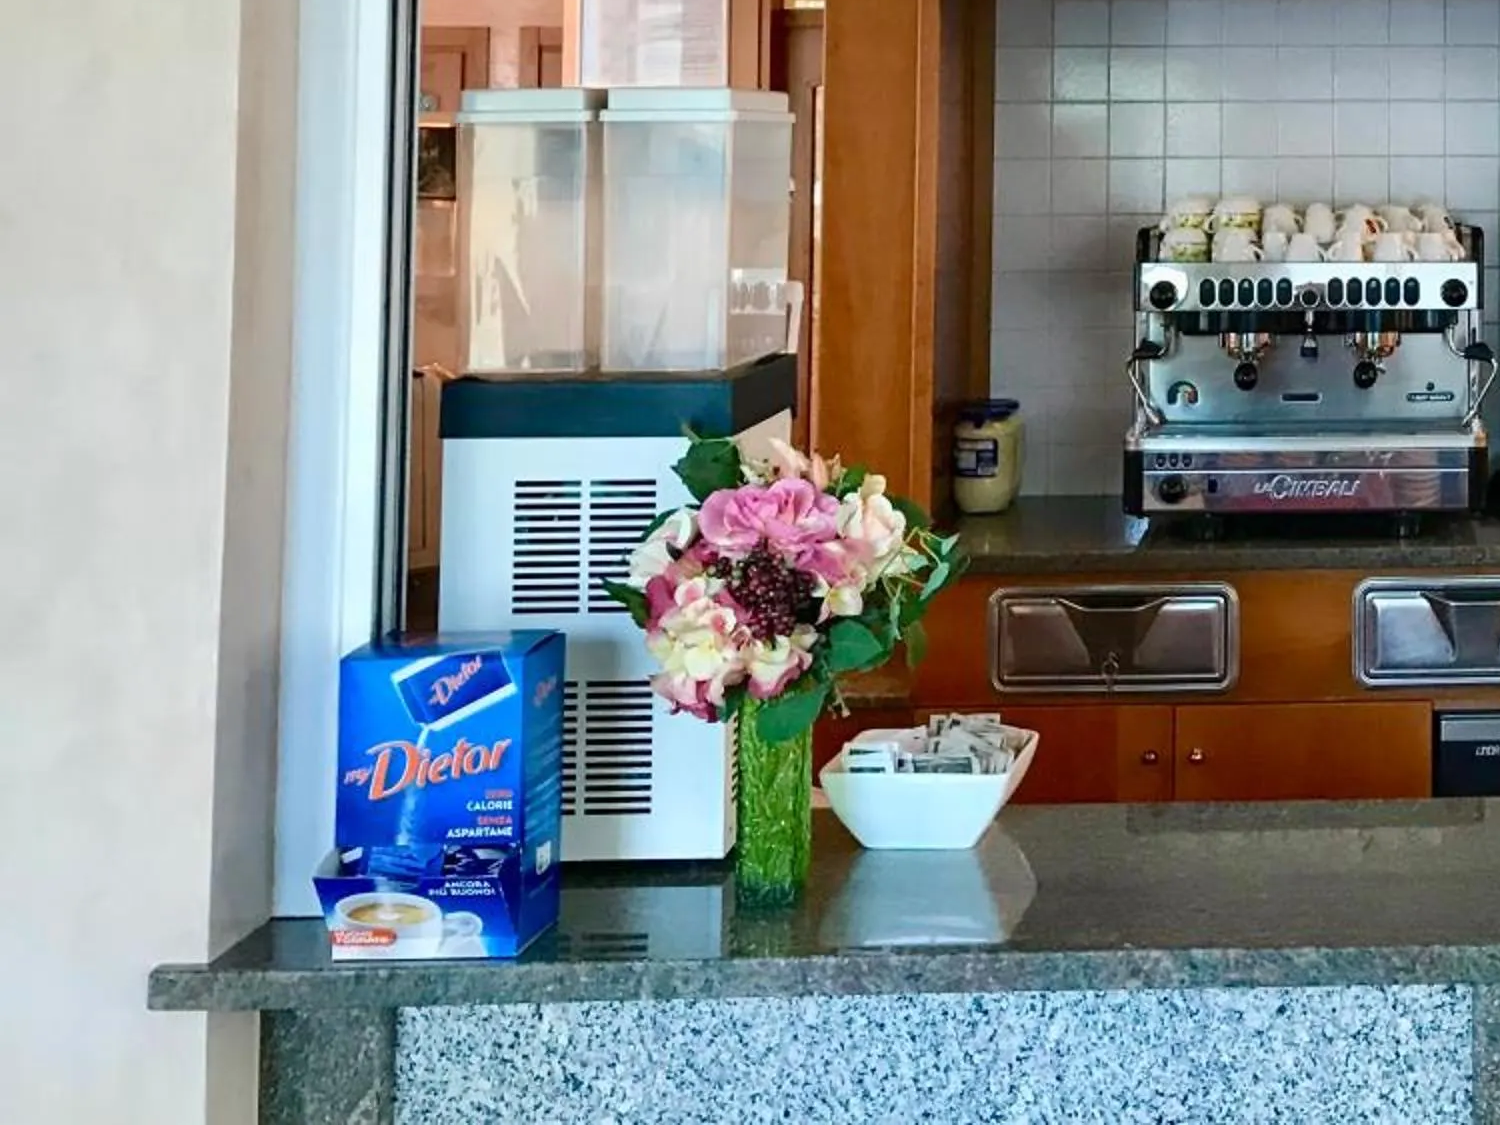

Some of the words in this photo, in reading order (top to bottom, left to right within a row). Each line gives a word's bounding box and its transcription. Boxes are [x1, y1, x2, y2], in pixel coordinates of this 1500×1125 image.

[366, 737, 512, 801] Dietor
[466, 800, 513, 812] CALORIE
[446, 826, 513, 839] ASPARTAME
